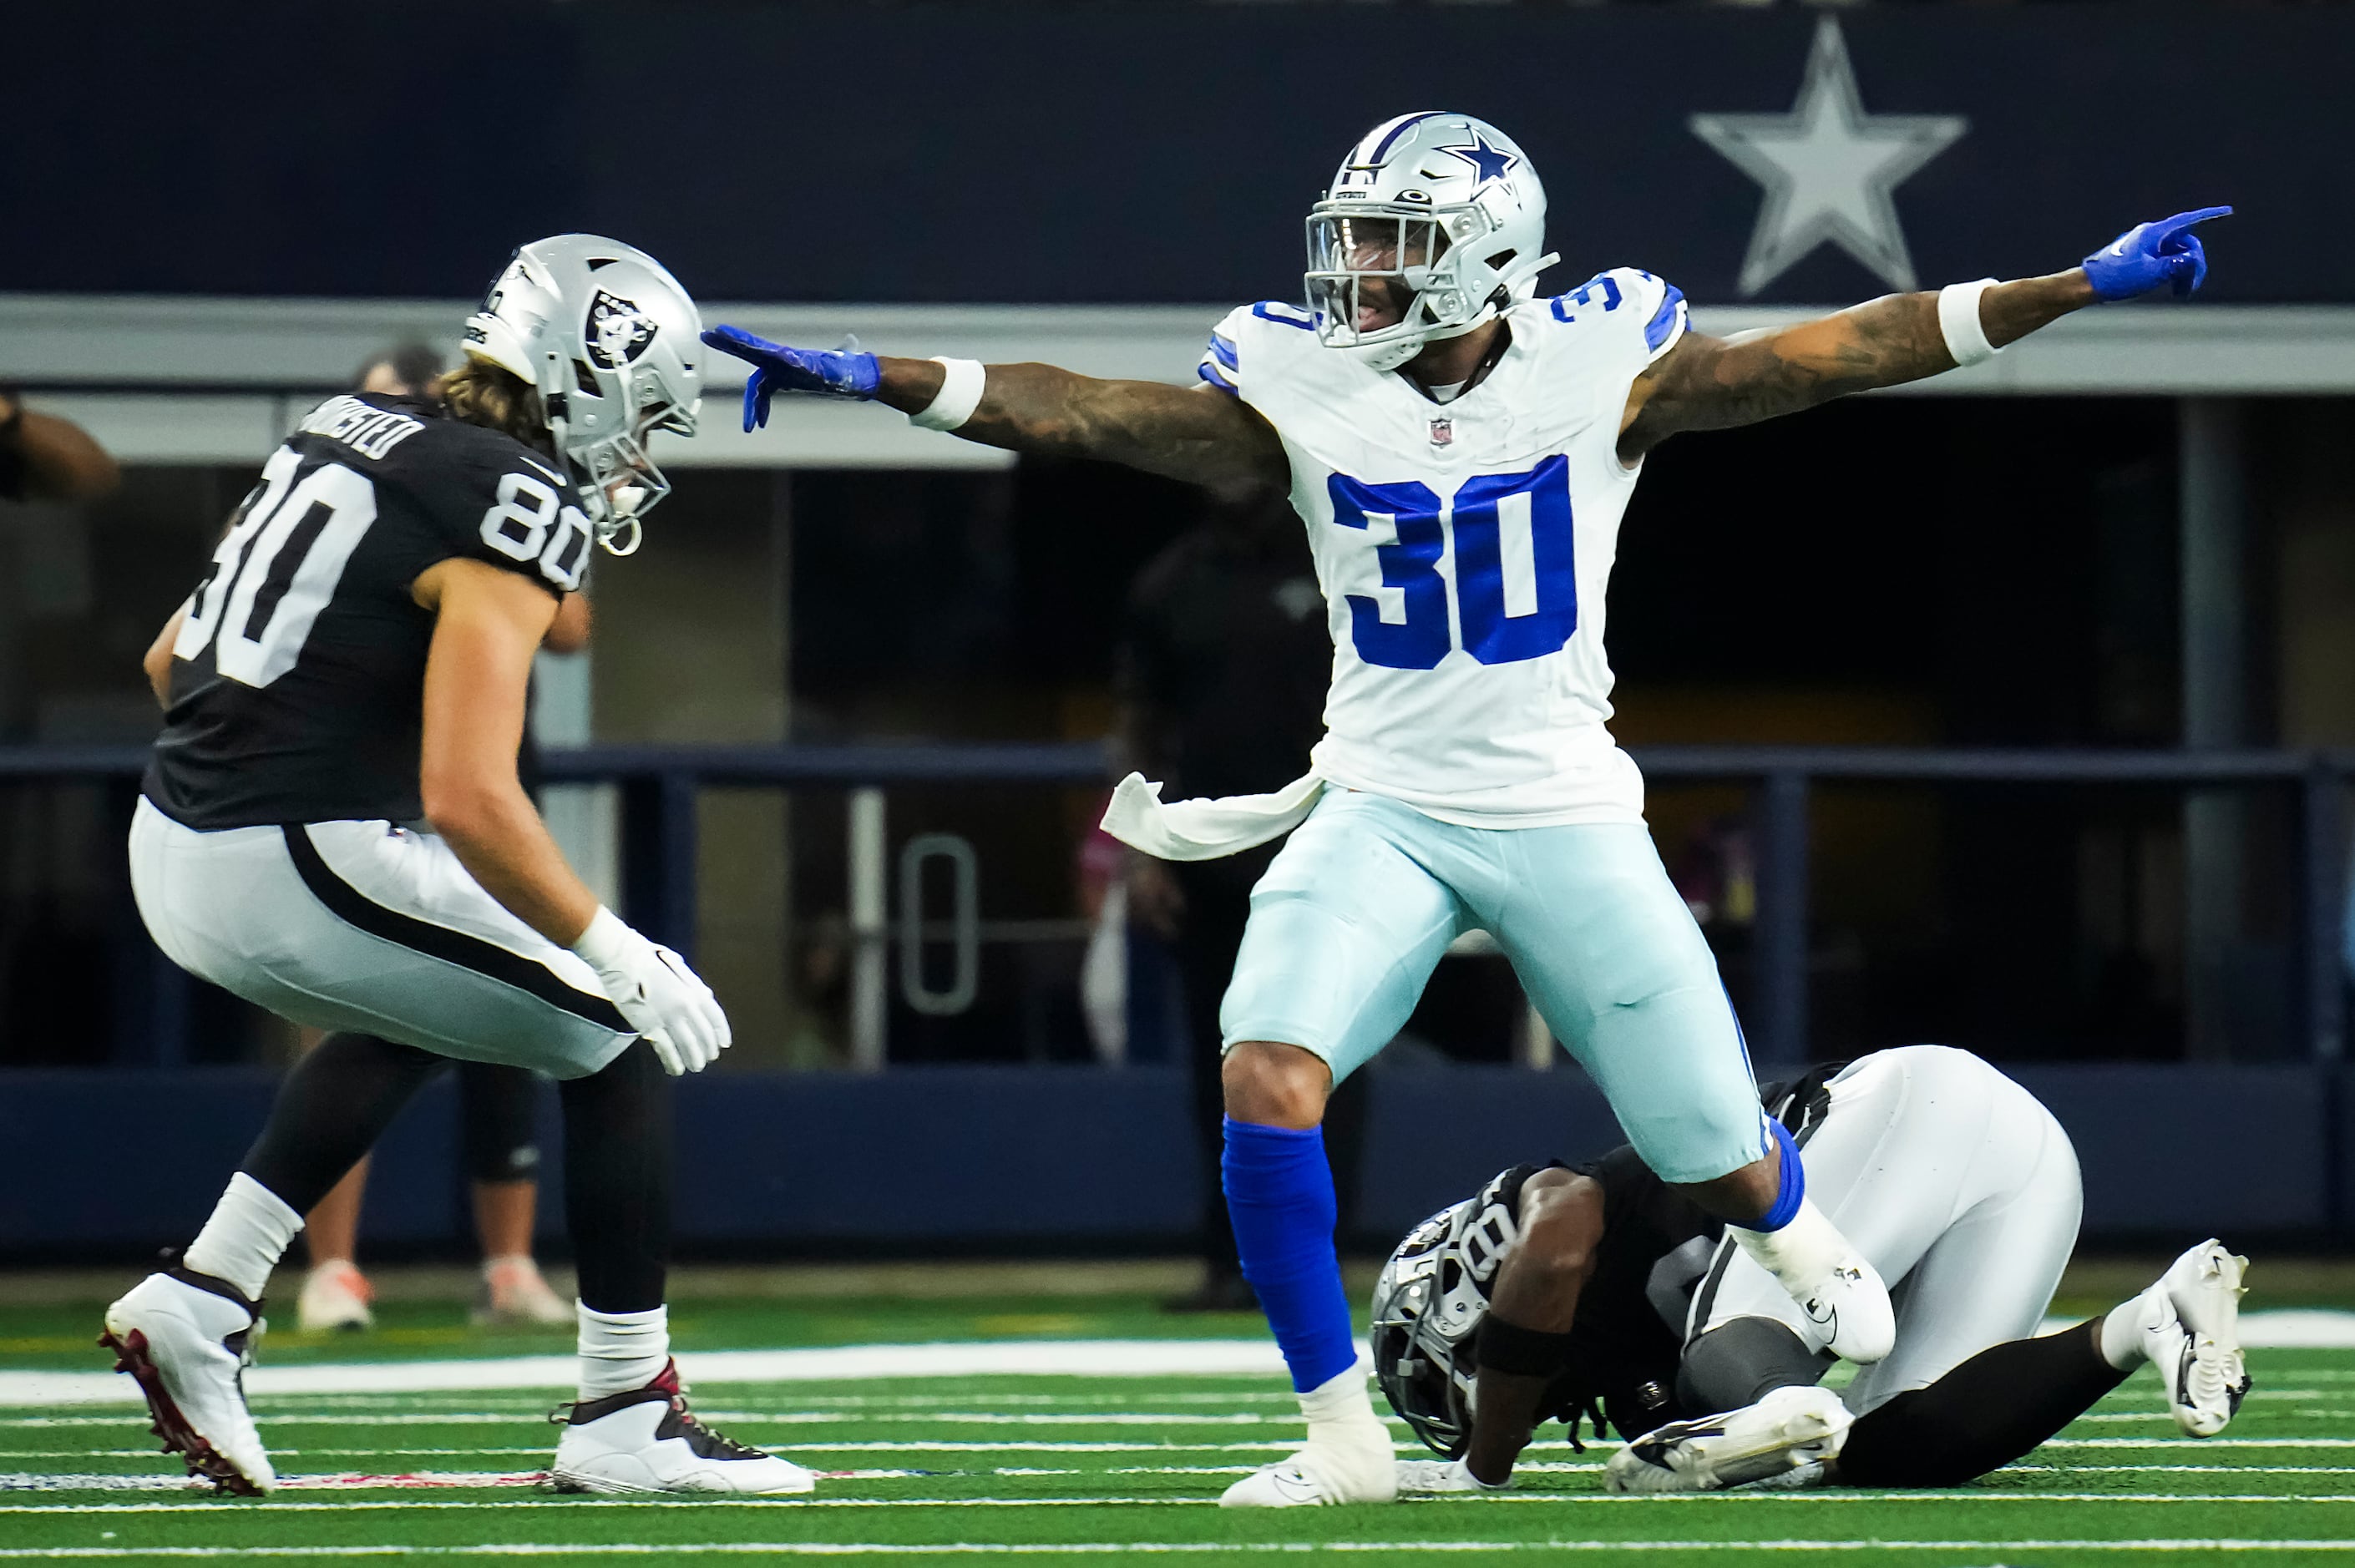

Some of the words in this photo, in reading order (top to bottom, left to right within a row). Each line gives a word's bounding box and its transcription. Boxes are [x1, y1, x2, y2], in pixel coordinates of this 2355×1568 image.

[298, 397, 427, 461] STED
[479, 472, 594, 593] 80
[1327, 453, 1578, 670] 30
